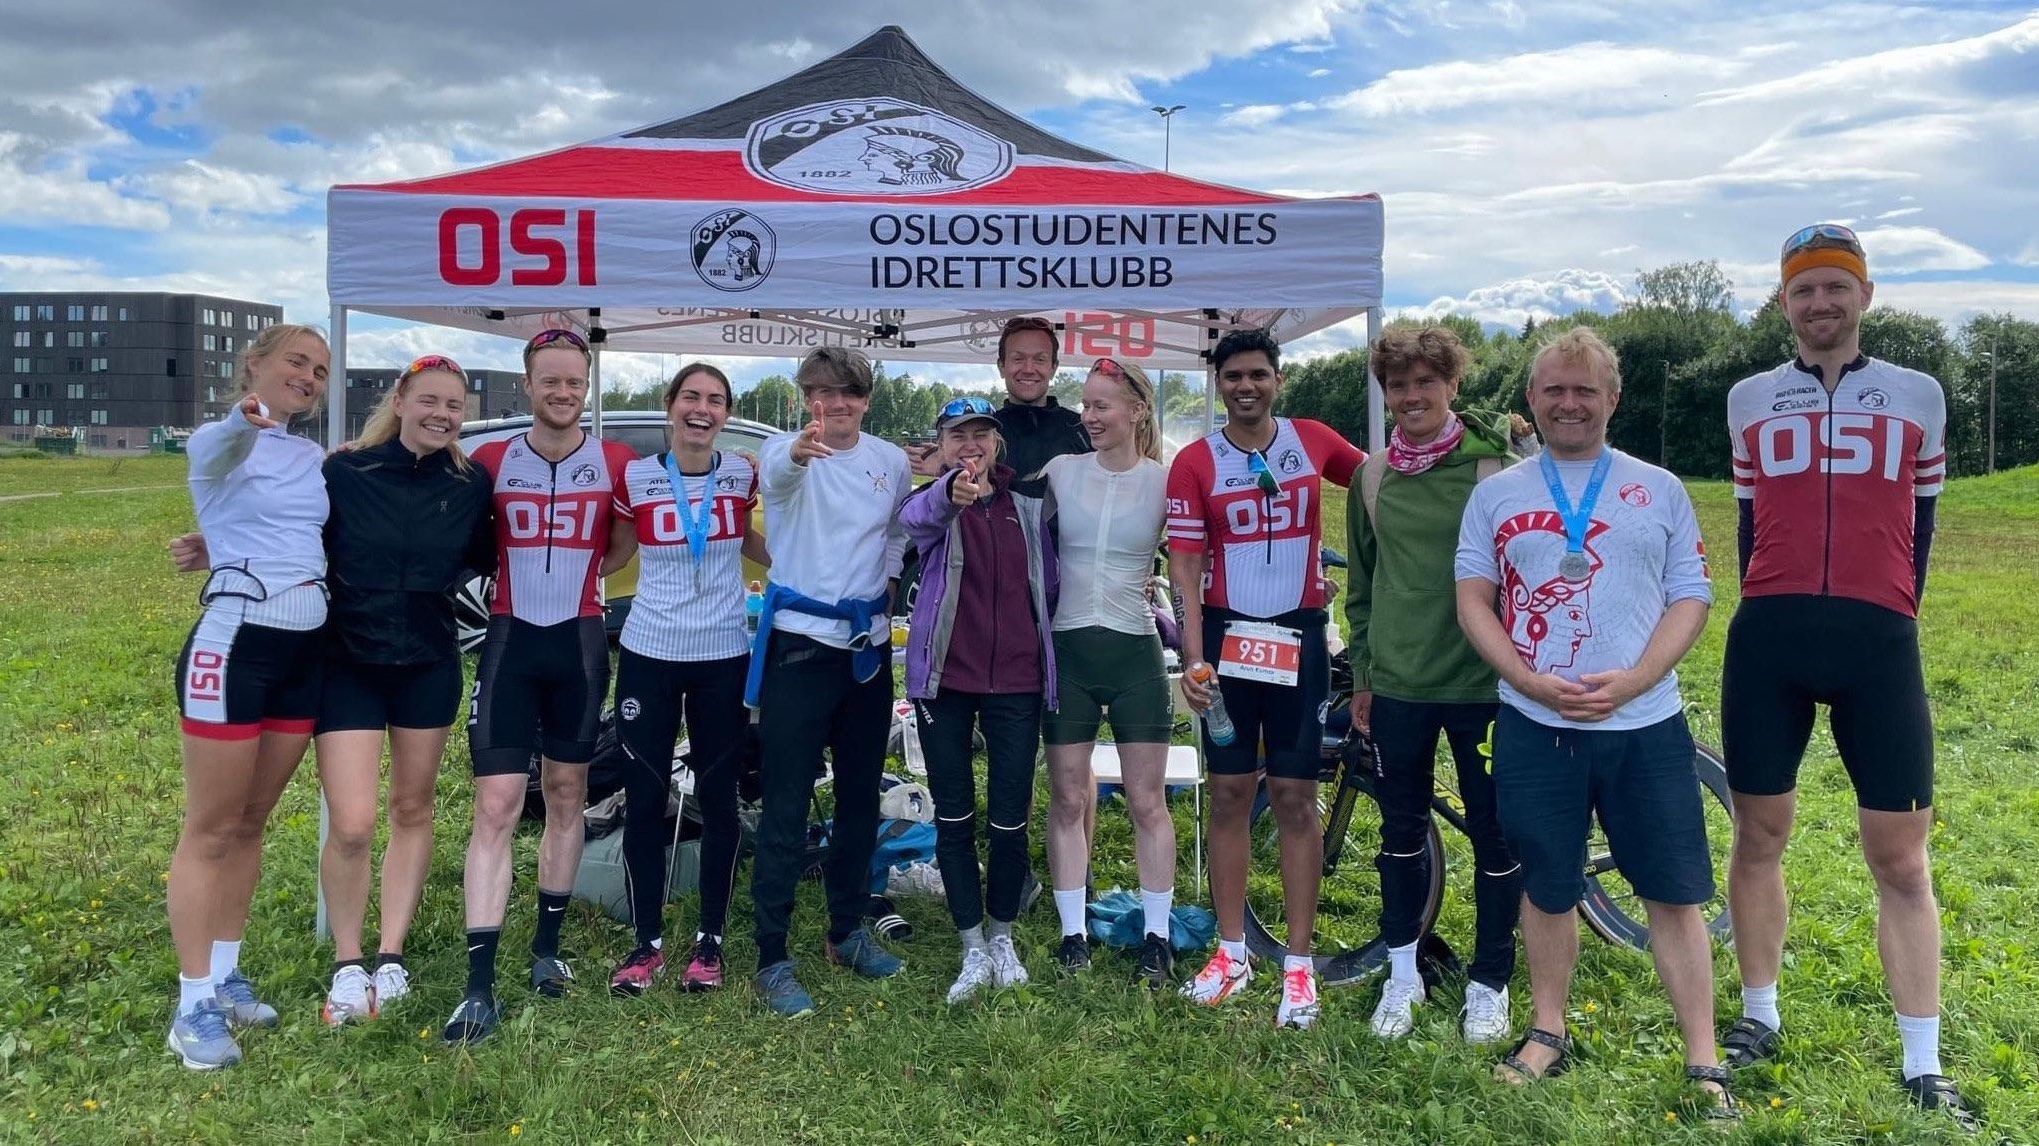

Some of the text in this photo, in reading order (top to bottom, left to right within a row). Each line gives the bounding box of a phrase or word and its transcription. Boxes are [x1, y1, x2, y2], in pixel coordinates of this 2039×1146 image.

[780, 104, 877, 138] OSI
[699, 213, 732, 244] OSI
[869, 213, 1277, 247] OSLOSTUDENTENES
[438, 207, 597, 287] OSI
[709, 269, 726, 277] 1882
[871, 256, 1173, 289] IDRETTSKLUBB
[1758, 413, 1904, 482] OSI
[505, 500, 598, 541] OSI
[1225, 486, 1308, 535] OSI
[1239, 639, 1278, 665] 951
[190, 650, 223, 701] OSI
